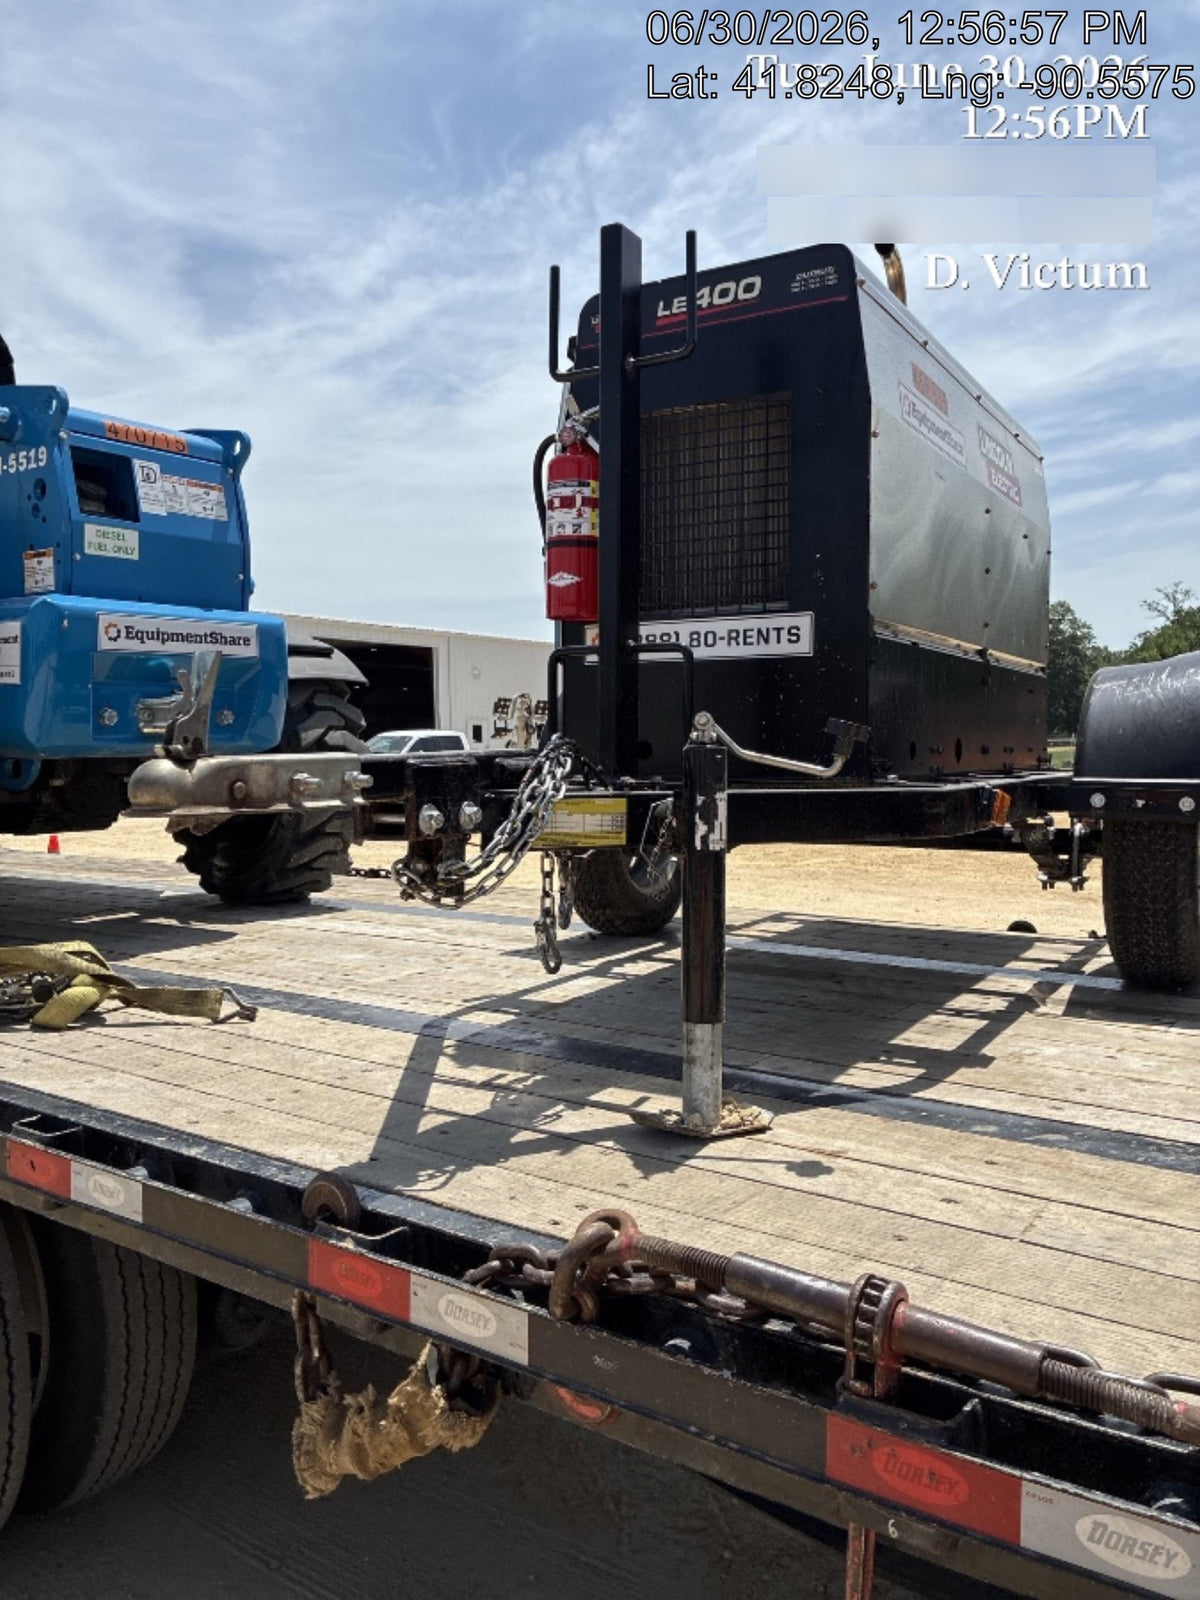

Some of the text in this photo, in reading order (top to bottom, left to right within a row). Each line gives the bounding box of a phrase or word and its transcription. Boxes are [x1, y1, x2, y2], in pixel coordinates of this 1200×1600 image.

[124, 625, 252, 646] EquipmentShare
[689, 625, 801, 648] 80-RENTS
[444, 1298, 490, 1331] DORSEY
[882, 1449, 960, 1500] DORSEY
[887, 1519, 899, 1539] 6
[1086, 1519, 1179, 1570] DORSEY
